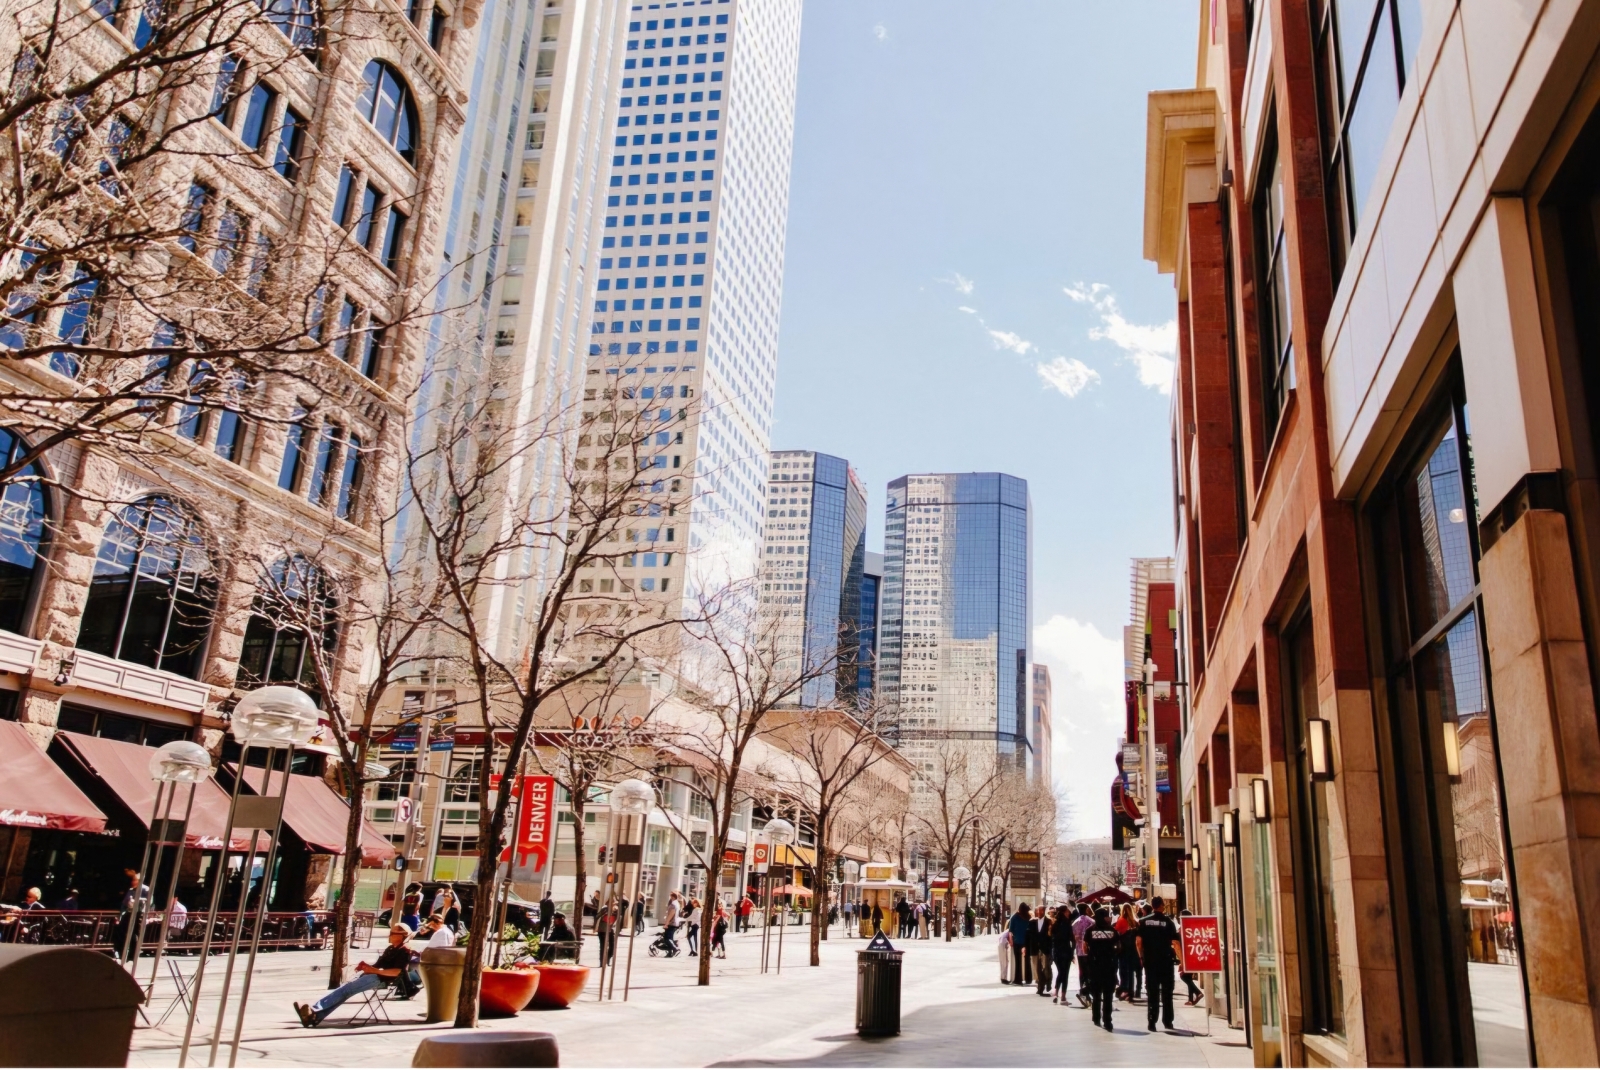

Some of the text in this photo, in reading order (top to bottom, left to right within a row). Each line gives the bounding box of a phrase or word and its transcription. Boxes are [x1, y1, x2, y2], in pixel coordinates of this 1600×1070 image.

[528, 782, 547, 843] DENVER
[1185, 926, 1217, 939] SALE
[1187, 944, 1216, 956] 70%
